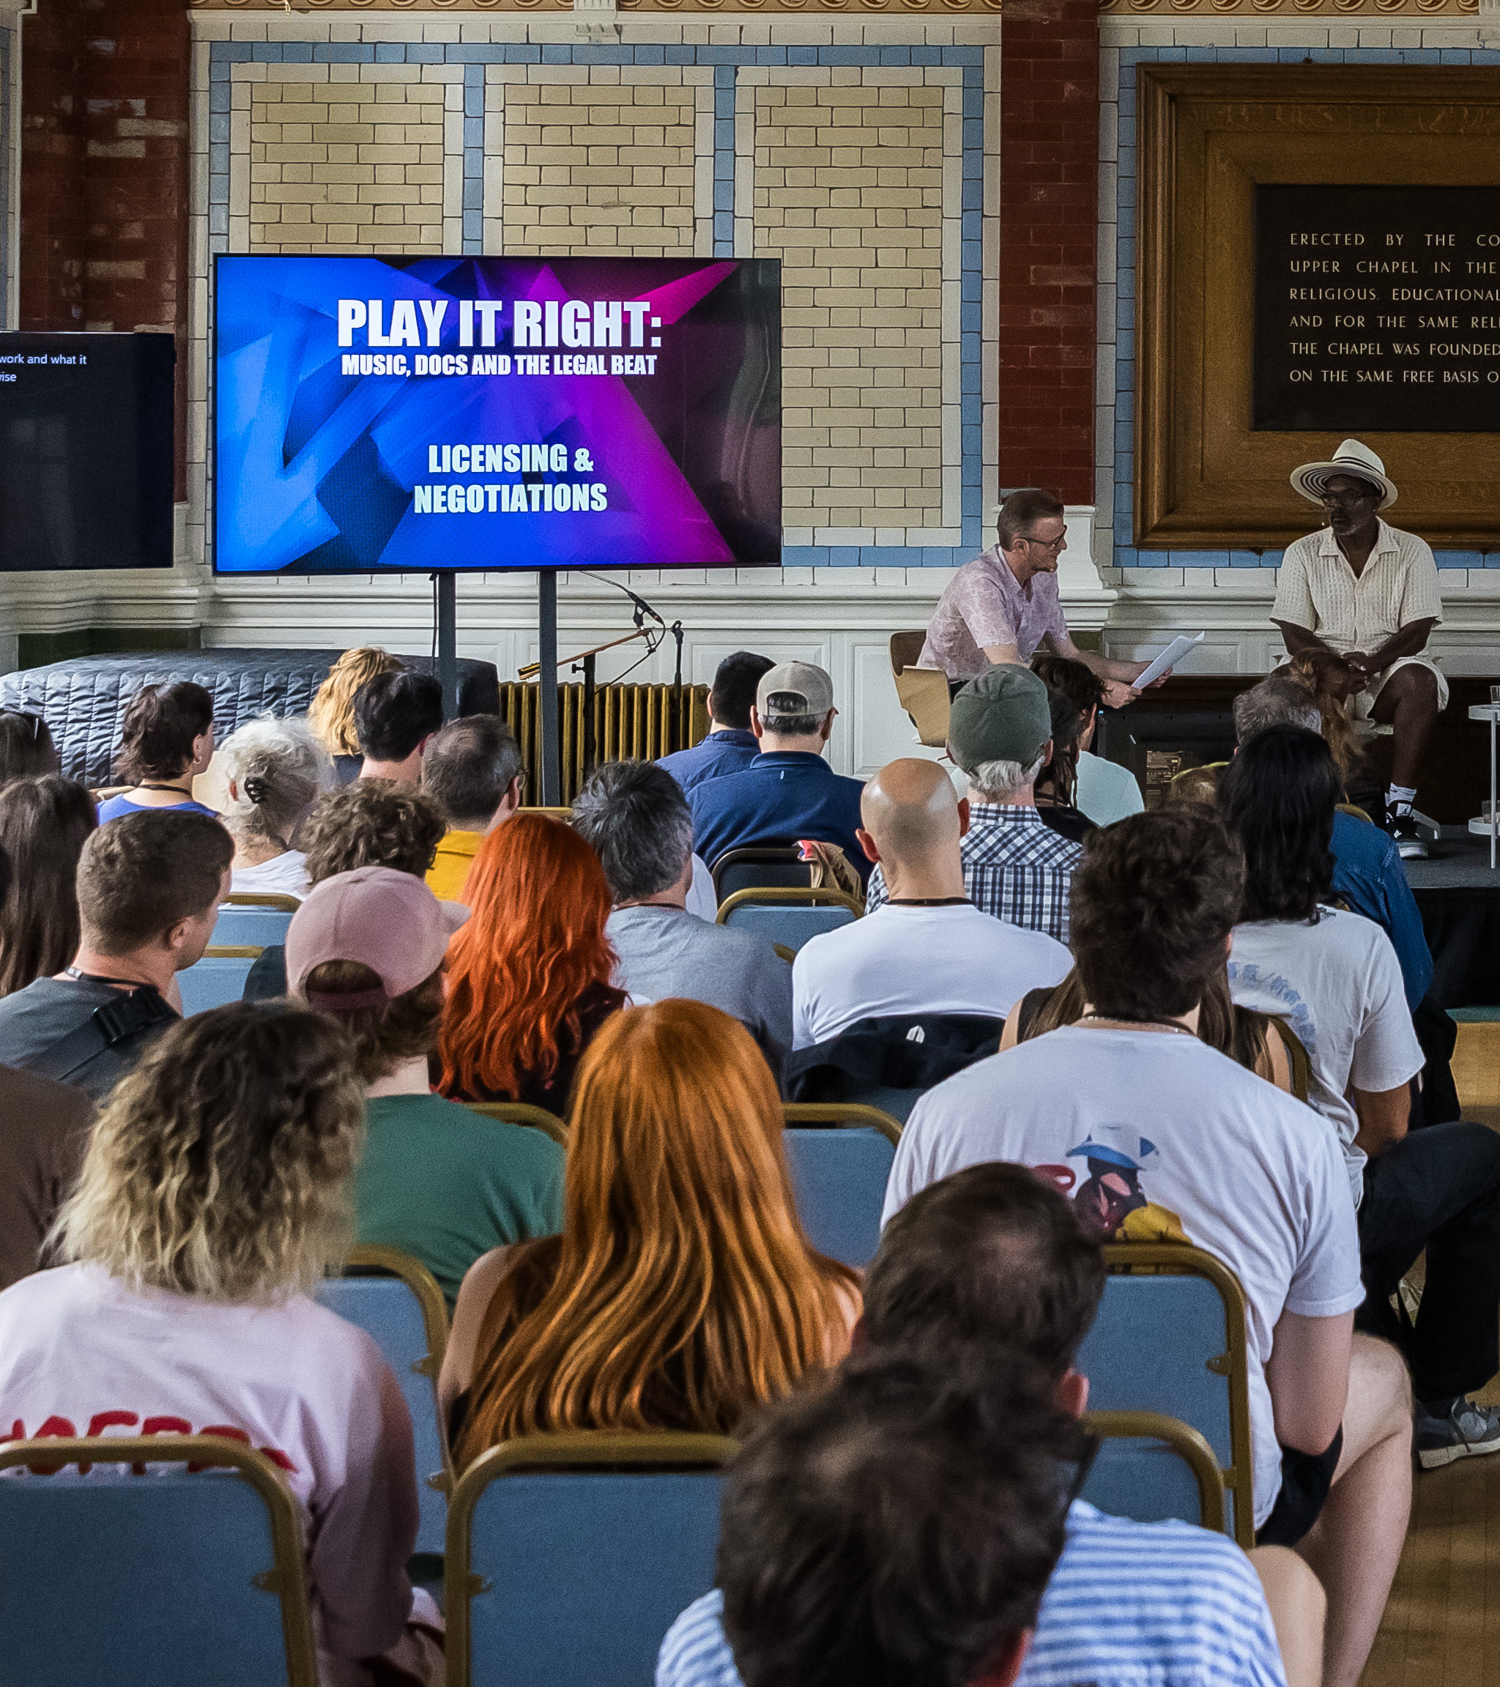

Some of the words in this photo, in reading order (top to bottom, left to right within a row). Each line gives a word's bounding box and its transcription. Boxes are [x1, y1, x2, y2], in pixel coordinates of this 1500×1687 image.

[1290, 233, 1364, 245] ERECTED
[1386, 233, 1403, 246] BY
[1424, 233, 1455, 246] THE
[1290, 260, 1339, 272] UPPER
[1356, 260, 1418, 273] CHAPEL
[1434, 261, 1450, 273] IN
[1466, 261, 1495, 274] THE
[338, 299, 448, 346] PLAY
[459, 300, 502, 346] IT
[513, 300, 661, 347] RIGHT:
[1289, 315, 1322, 327] AND
[1335, 315, 1365, 327] FOR
[1377, 315, 1405, 328] THE
[1418, 315, 1458, 328] SAME
[1289, 342, 1317, 354] THE
[1327, 342, 1383, 355] CHAPEL
[1392, 342, 1420, 355] WAS
[26, 353, 47, 364] and
[50, 353, 76, 364] what
[79, 354, 86, 364] it
[342, 354, 410, 376] MUSIC,
[415, 354, 468, 375] DOCS
[471, 354, 510, 374] AND
[514, 354, 549, 374] THE
[553, 354, 607, 374] LEGAL
[611, 355, 657, 374] BEAT
[1289, 369, 1312, 382] ON
[1321, 369, 1347, 382] THE
[1356, 370, 1392, 382] SAME
[1403, 370, 1434, 382] FREE
[1443, 370, 1479, 383] BASIS
[428, 443, 567, 473] LICENSING
[574, 448, 593, 471] &
[414, 483, 607, 513] NEGOTIATIONS
